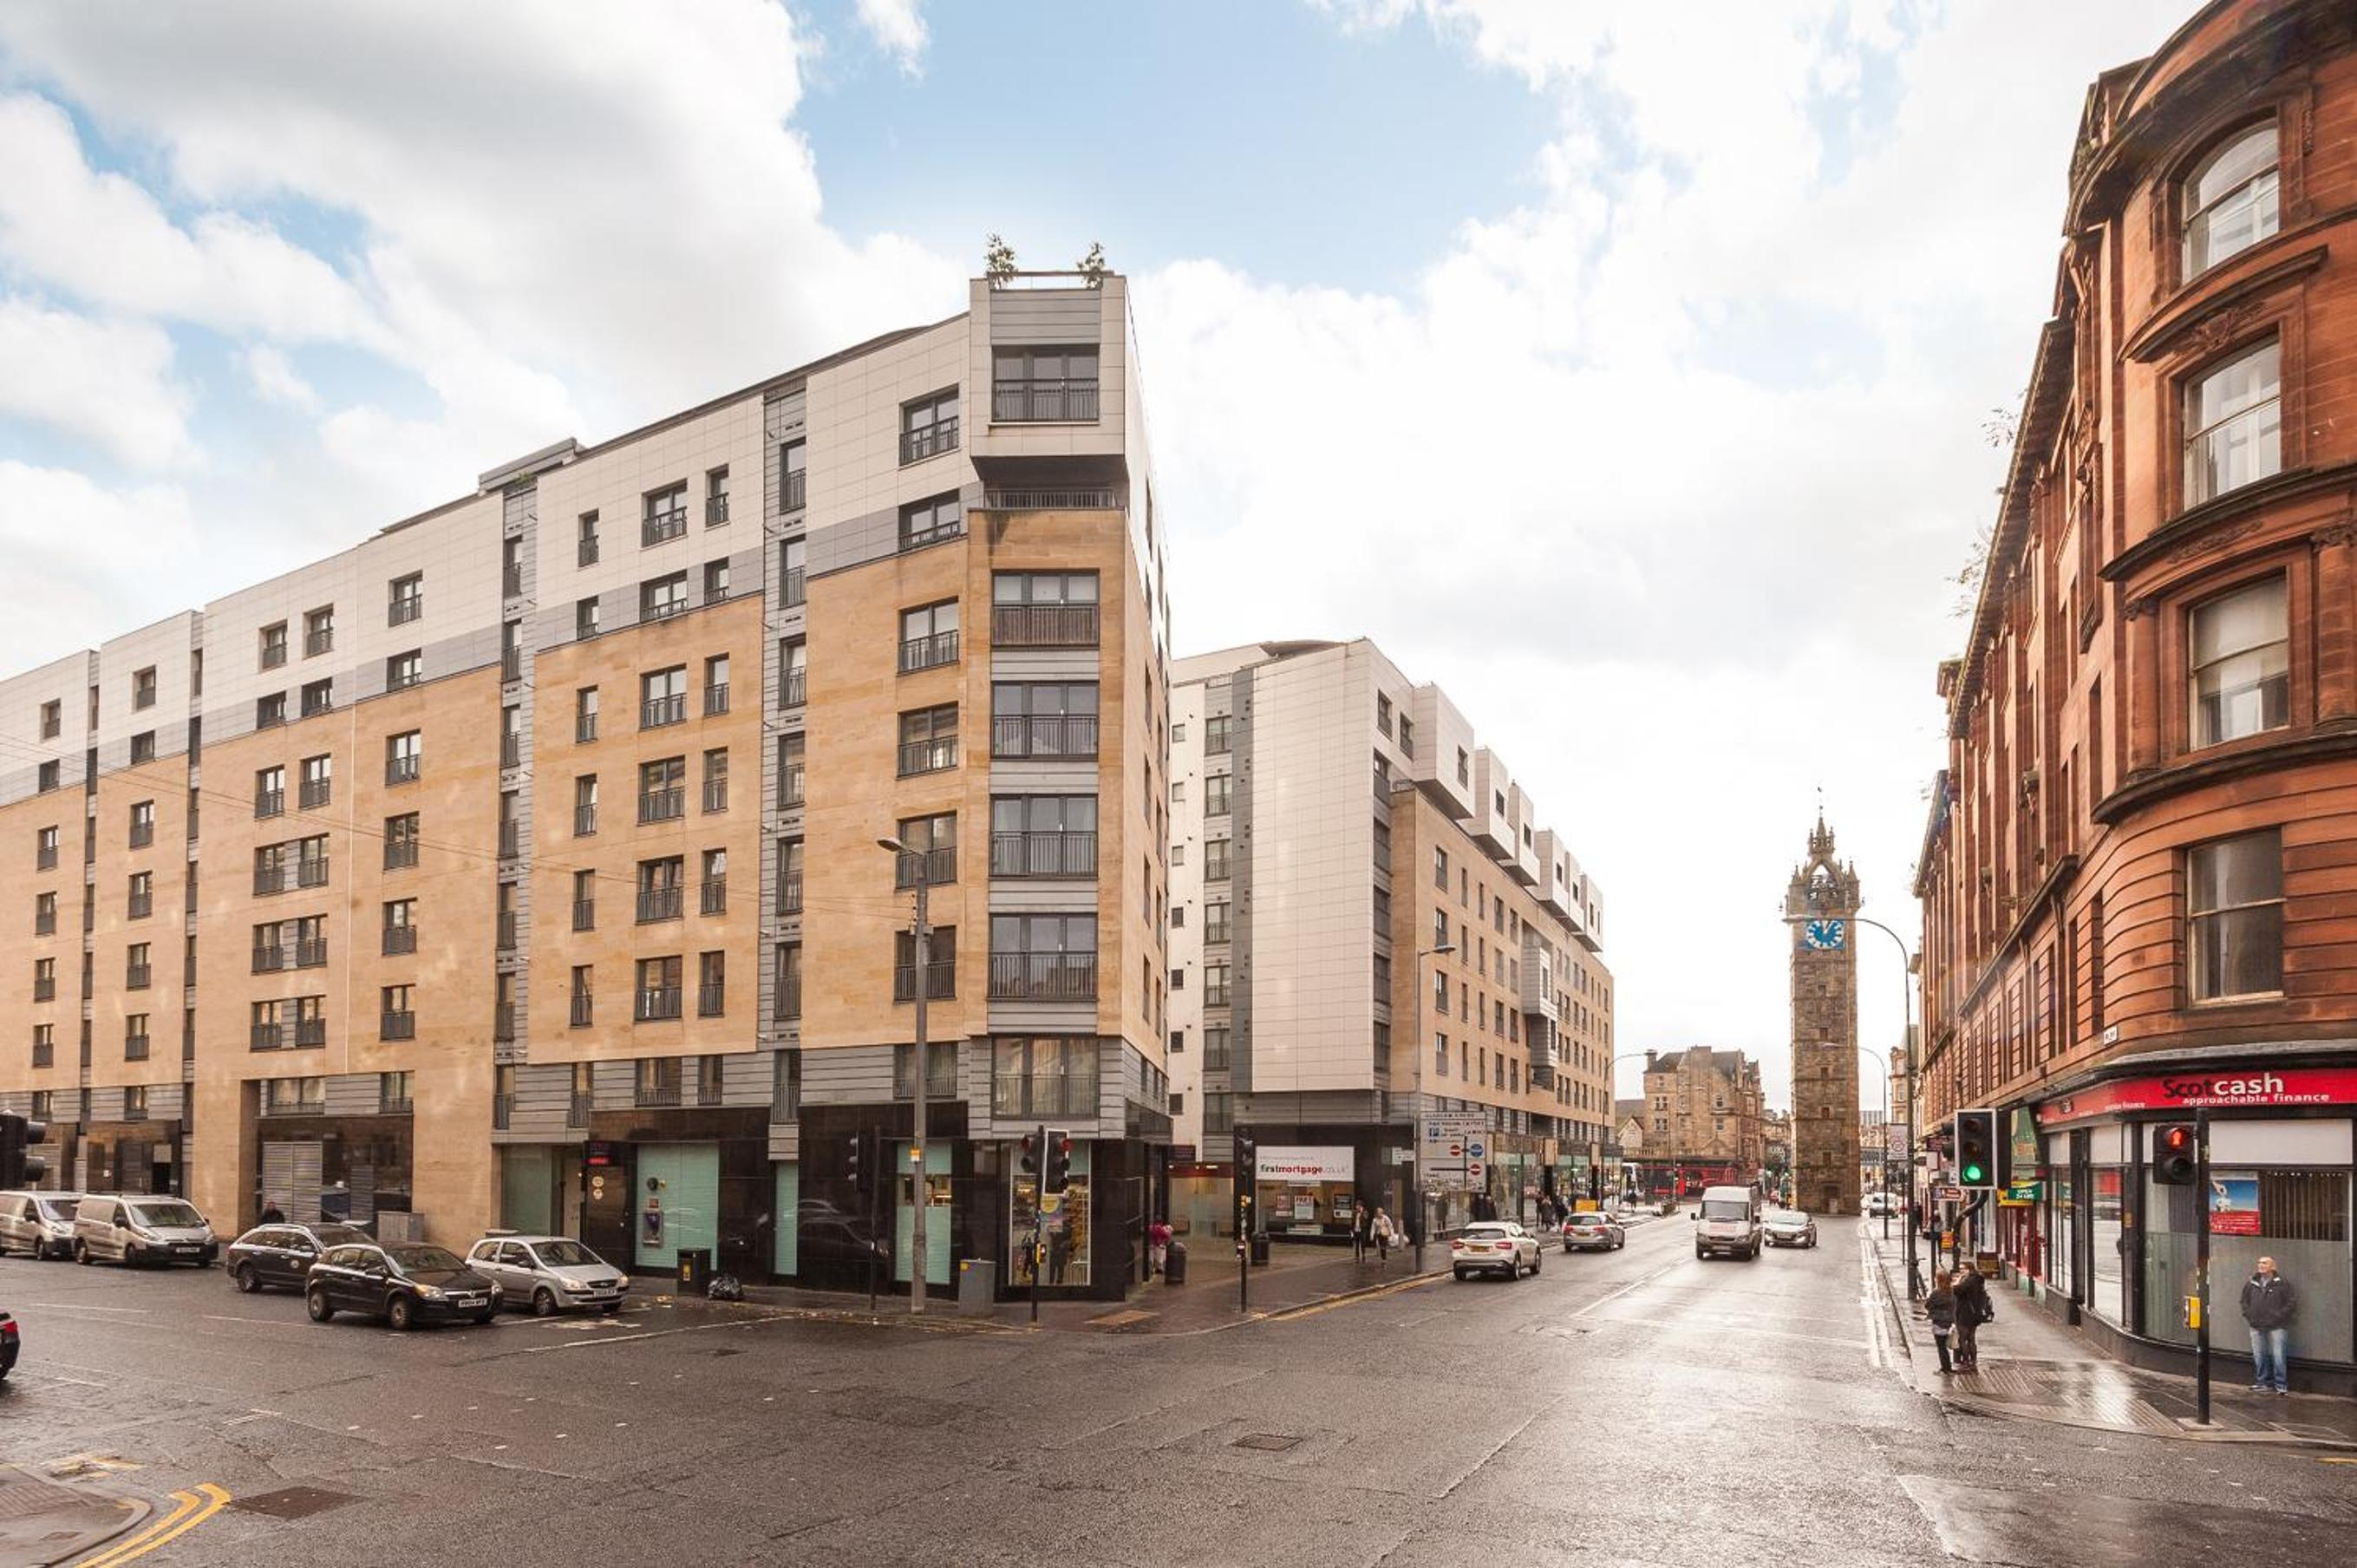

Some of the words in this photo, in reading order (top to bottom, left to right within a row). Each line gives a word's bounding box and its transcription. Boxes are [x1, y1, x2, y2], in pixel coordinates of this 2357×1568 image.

[2162, 1072, 2284, 1099] Scotcash
[2182, 1094, 2269, 1106] approachable
[2274, 1093, 2330, 1103] finance
